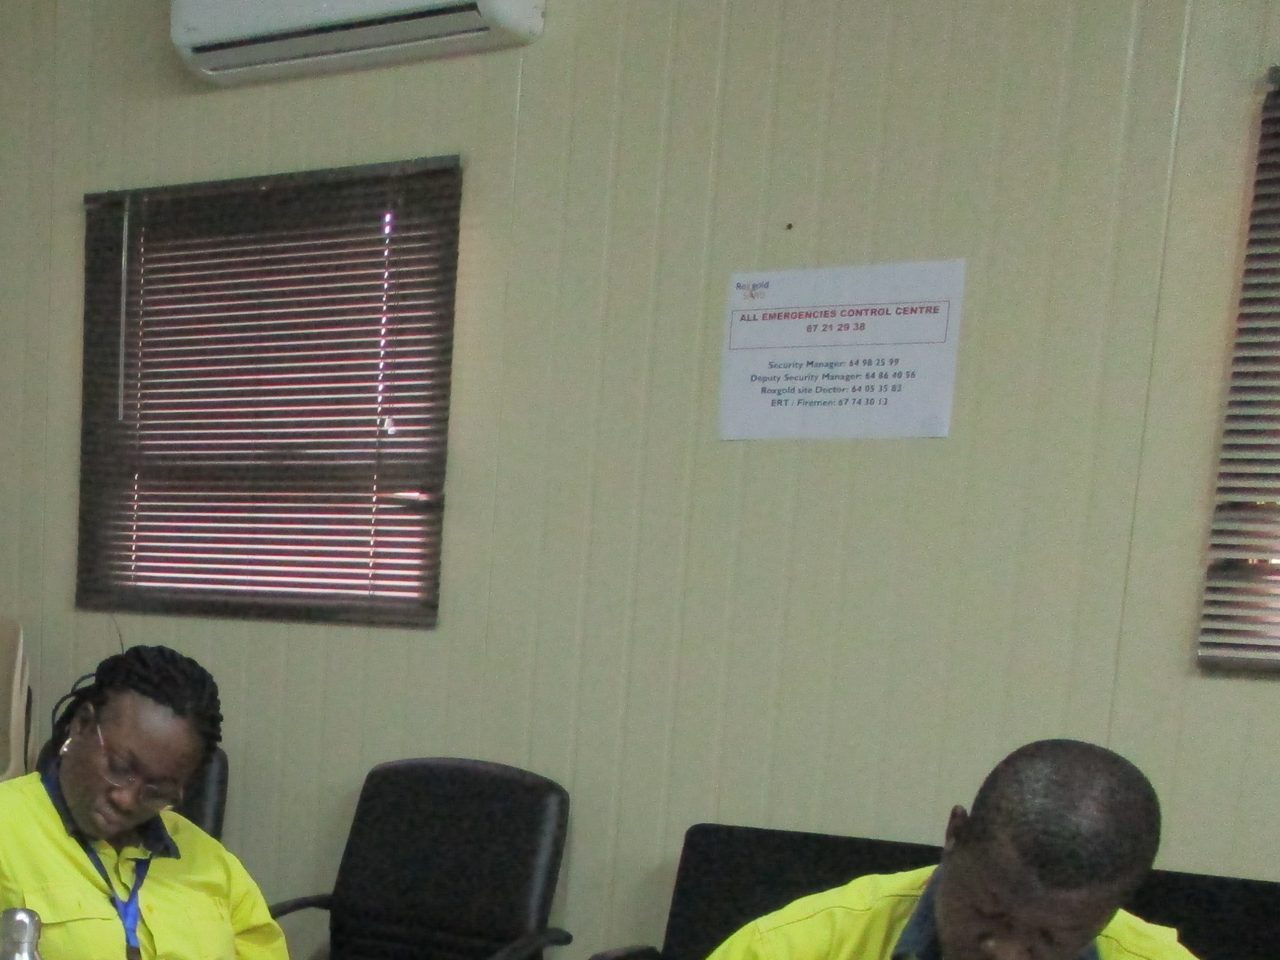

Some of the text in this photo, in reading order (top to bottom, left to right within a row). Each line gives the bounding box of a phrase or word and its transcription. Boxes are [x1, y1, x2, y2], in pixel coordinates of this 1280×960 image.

[740, 305, 940, 321] ALL EMERGENCIES CONTROL CENTRE
[822, 323, 833, 332] 21
[768, 361, 803, 369] Security
[806, 360, 846, 369] Manager:
[750, 374, 781, 383] Deputy
[784, 373, 819, 382] Security
[822, 372, 862, 382] Manager:
[761, 386, 795, 396] Roxgold
[798, 386, 812, 394] site
[815, 385, 849, 394] Doctor:
[771, 399, 789, 407] ERT
